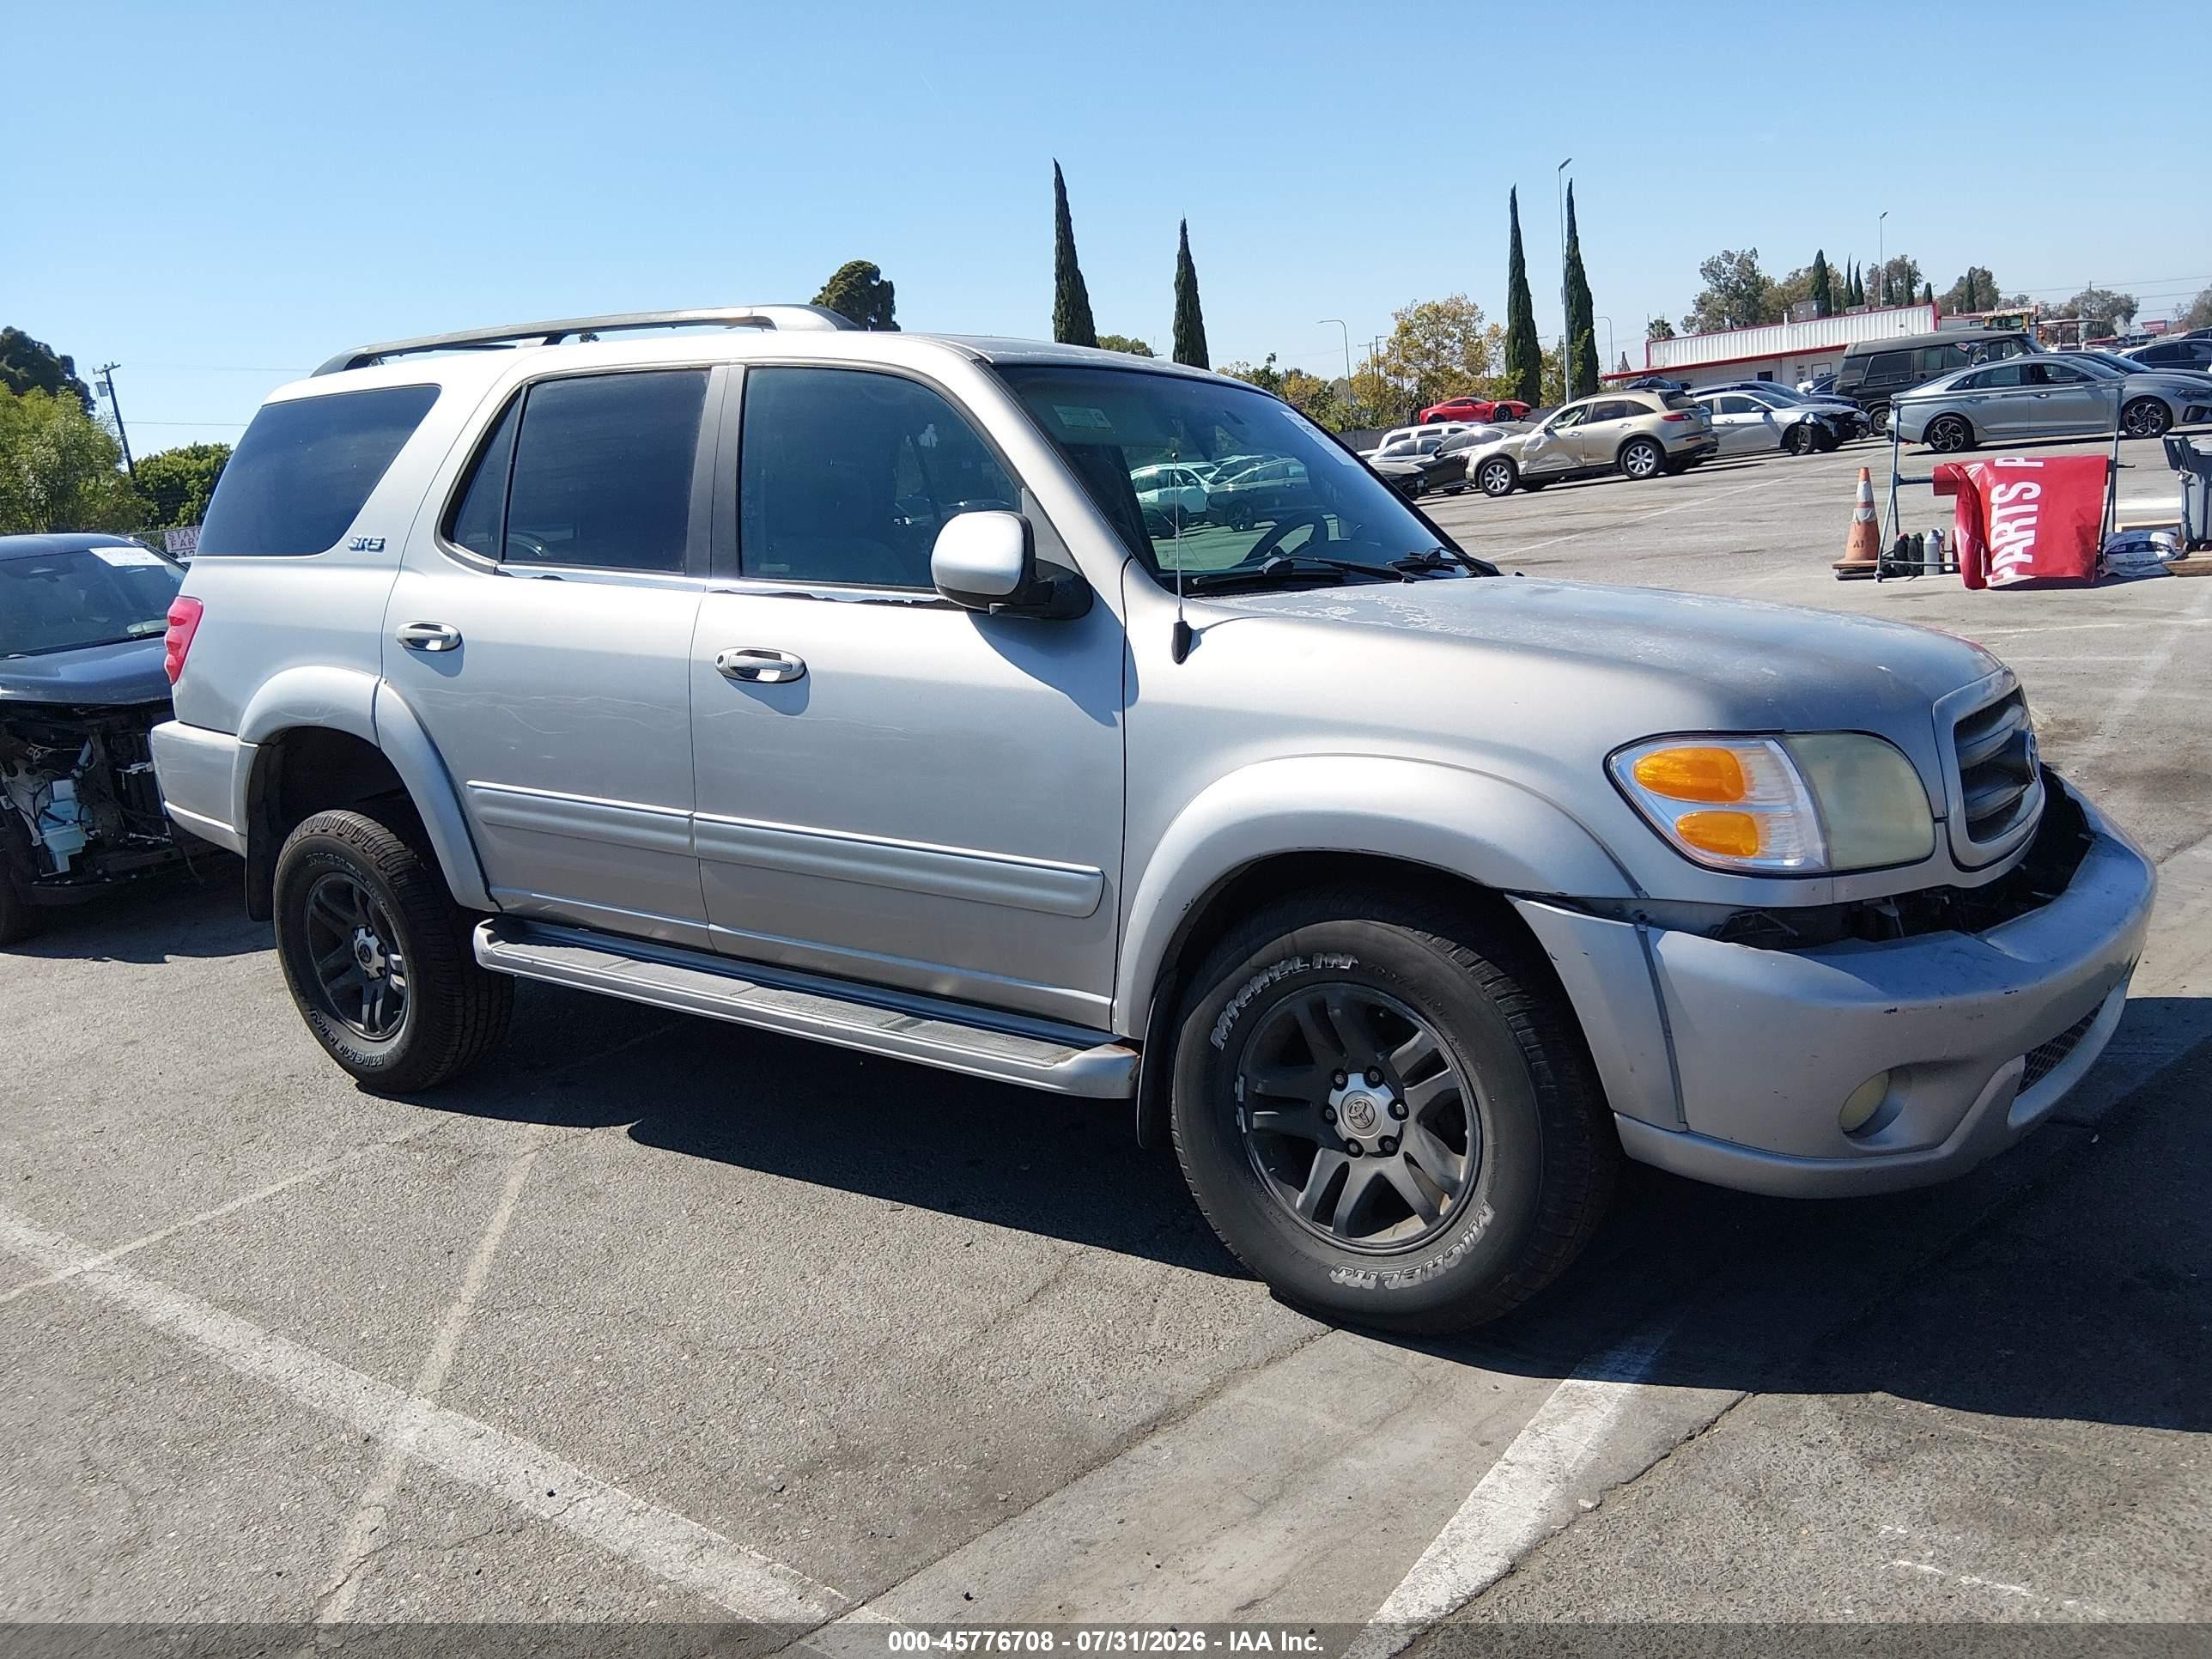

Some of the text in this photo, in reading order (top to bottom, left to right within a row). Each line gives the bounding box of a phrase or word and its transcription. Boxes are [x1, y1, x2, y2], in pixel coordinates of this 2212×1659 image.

[171, 538, 198, 549] FAR
[348, 534, 386, 552] SR5
[1986, 481, 2043, 586] PARTS
[1210, 951, 1359, 1050] MICHELIN
[308, 1009, 386, 1067] MICHELIN
[1328, 1199, 1496, 1290] MICHELIN
